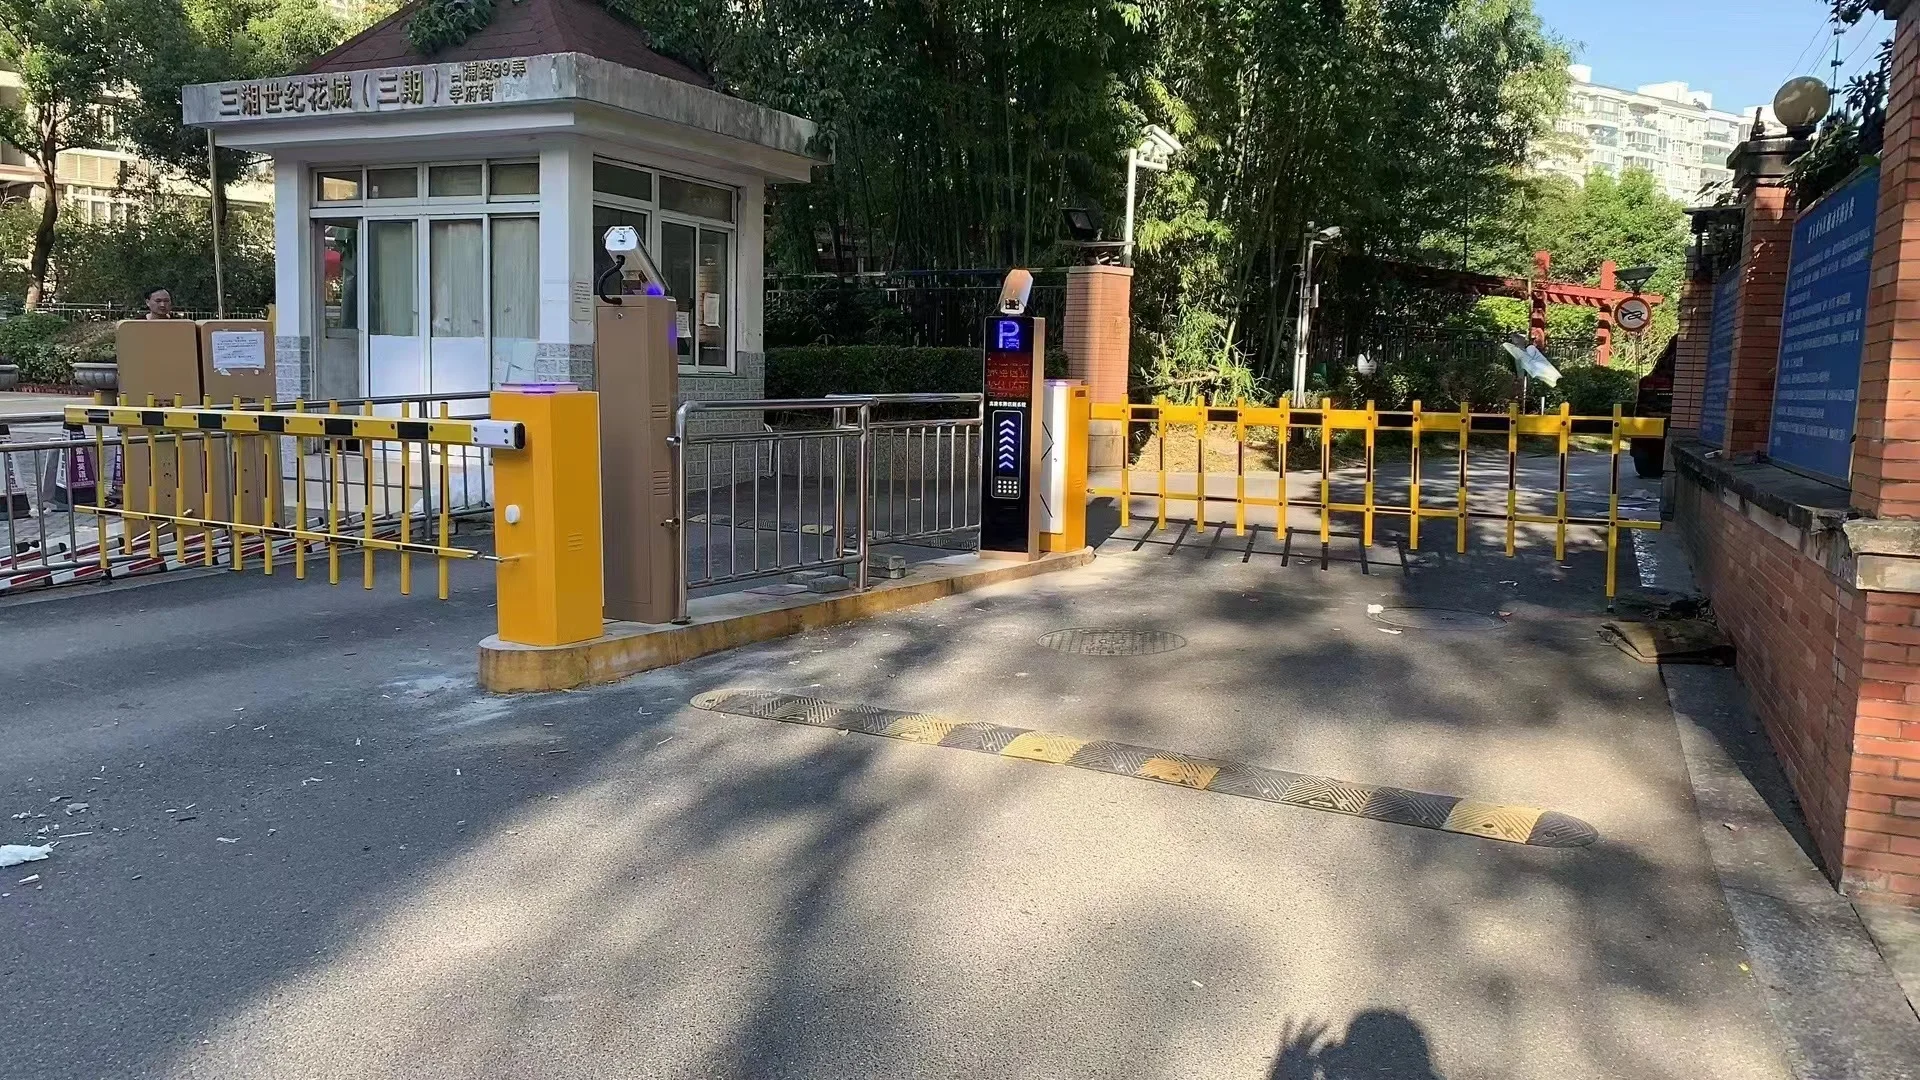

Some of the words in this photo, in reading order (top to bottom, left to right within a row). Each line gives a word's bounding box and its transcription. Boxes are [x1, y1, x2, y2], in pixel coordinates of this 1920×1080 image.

[449, 82, 495, 104] 学府街
[998, 320, 1020, 349] P
